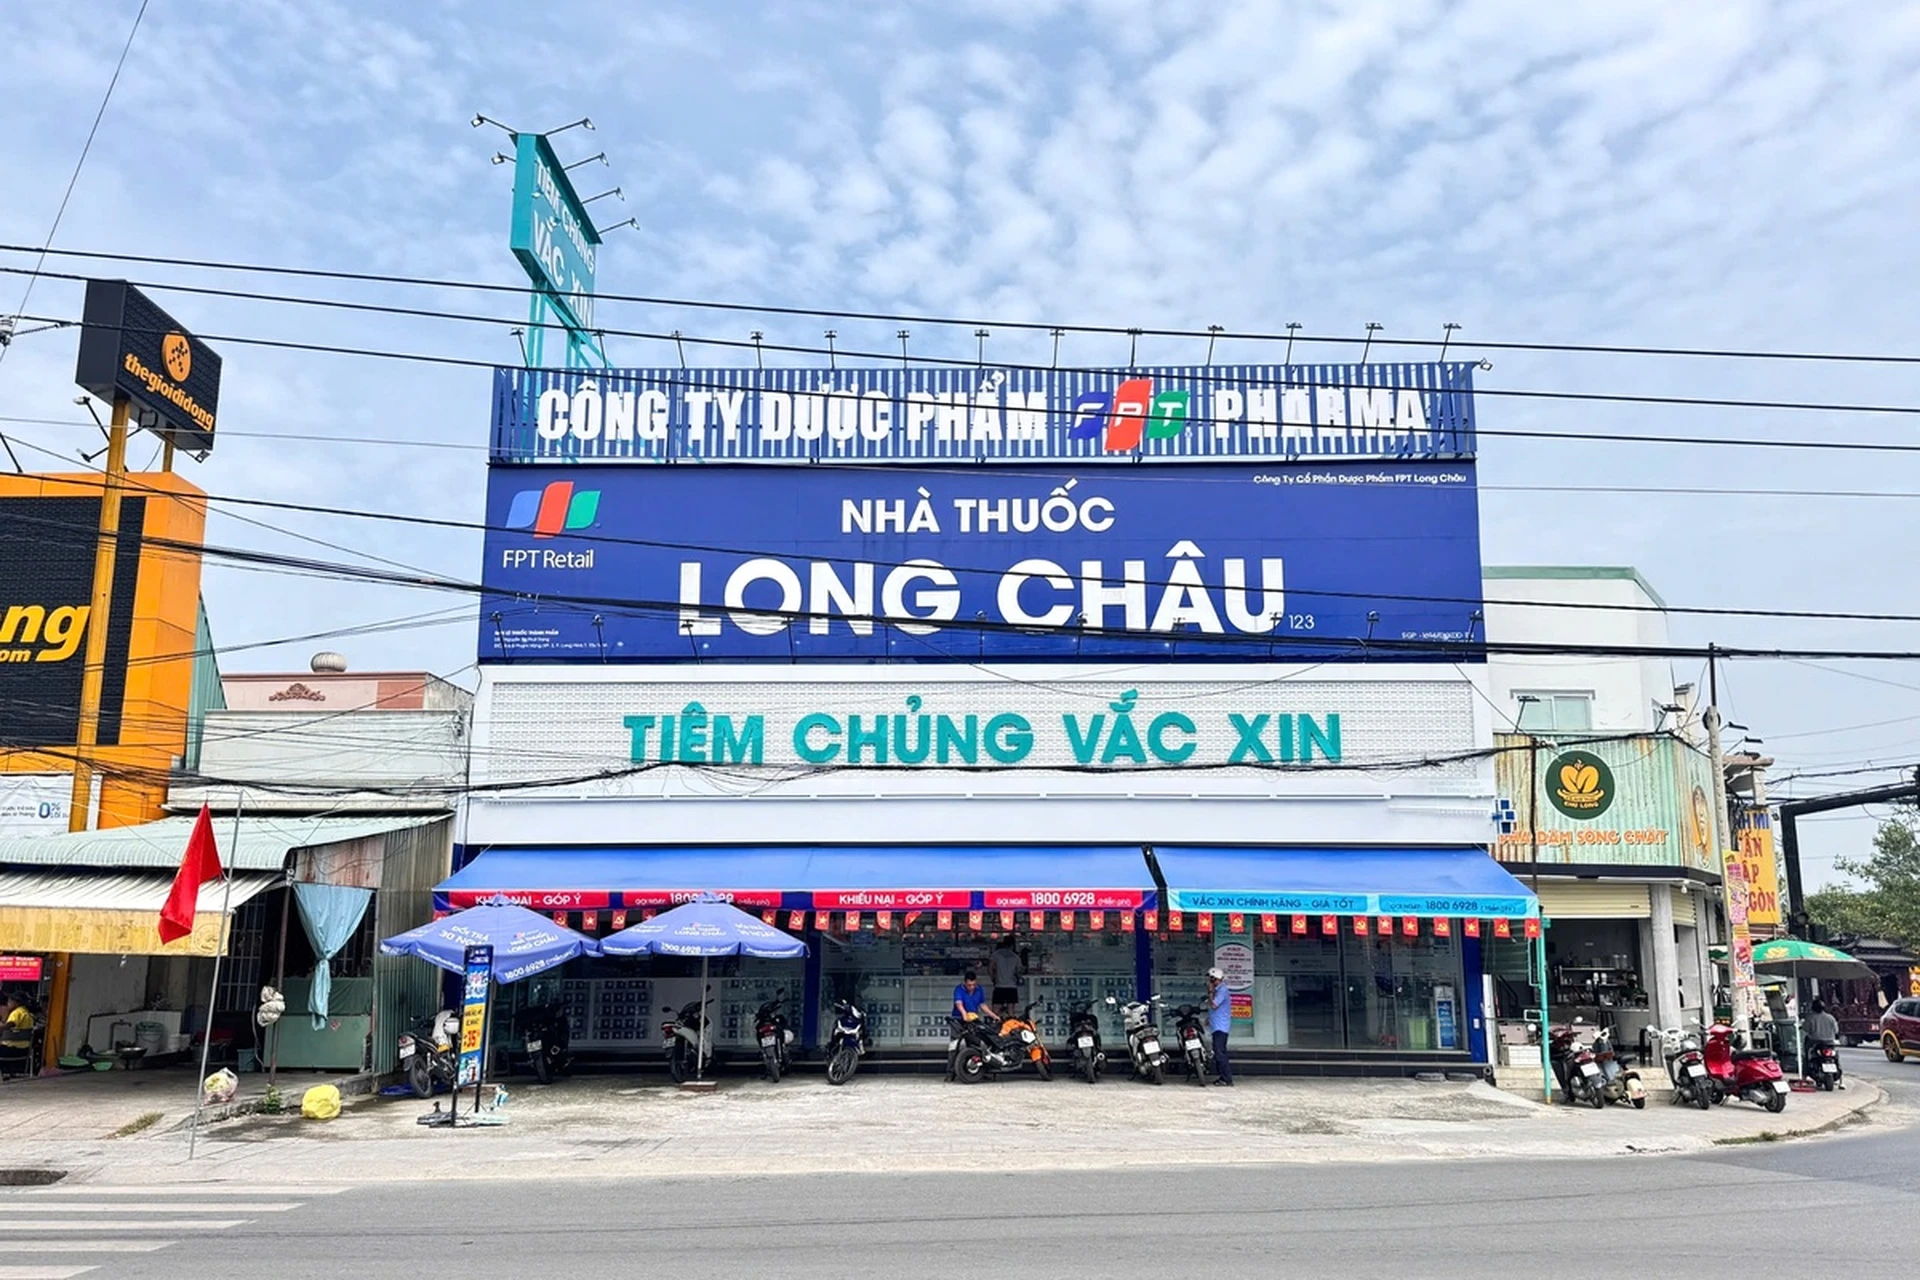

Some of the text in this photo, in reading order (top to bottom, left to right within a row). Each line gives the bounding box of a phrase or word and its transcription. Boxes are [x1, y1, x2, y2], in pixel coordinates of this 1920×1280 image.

[124, 353, 214, 432] thegioididong
[537, 380, 669, 441] CÔNG
[684, 391, 746, 441] TY
[762, 382, 890, 451] DƯỢC
[907, 371, 1048, 441] PHẨM
[1214, 388, 1429, 439] PHARMA
[1253, 474, 1281, 486] Công
[1282, 474, 1294, 485] Ty
[1395, 474, 1412, 483] FPT
[1414, 474, 1438, 485] Long
[1439, 473, 1467, 483] Châu
[841, 477, 1116, 534] NHÀ THUỐC
[502, 549, 594, 568] FPT Retail
[678, 540, 1285, 637] LONG CHÂU
[1288, 614, 1315, 630] 123
[0, 604, 91, 662] ng
[0, 650, 31, 662] om
[622, 688, 1343, 765] TIÊM CHỦNG VẮC XIN
[543, 892, 570, 905] GÓP
[839, 890, 944, 908] KHIẾU NẠI GÓP Ý
[1030, 892, 1060, 905] 1800
[1063, 892, 1095, 905] 6928
[1192, 893, 1216, 906] VẮC
[1217, 897, 1234, 906] XIN
[1237, 895, 1269, 907] CHÍNH
[1311, 897, 1331, 909] GIÁ
[1425, 900, 1450, 910] 1800
[1452, 901, 1478, 911] 6928
[504, 967, 525, 980] 1800
[525, 960, 546, 973] 6928
